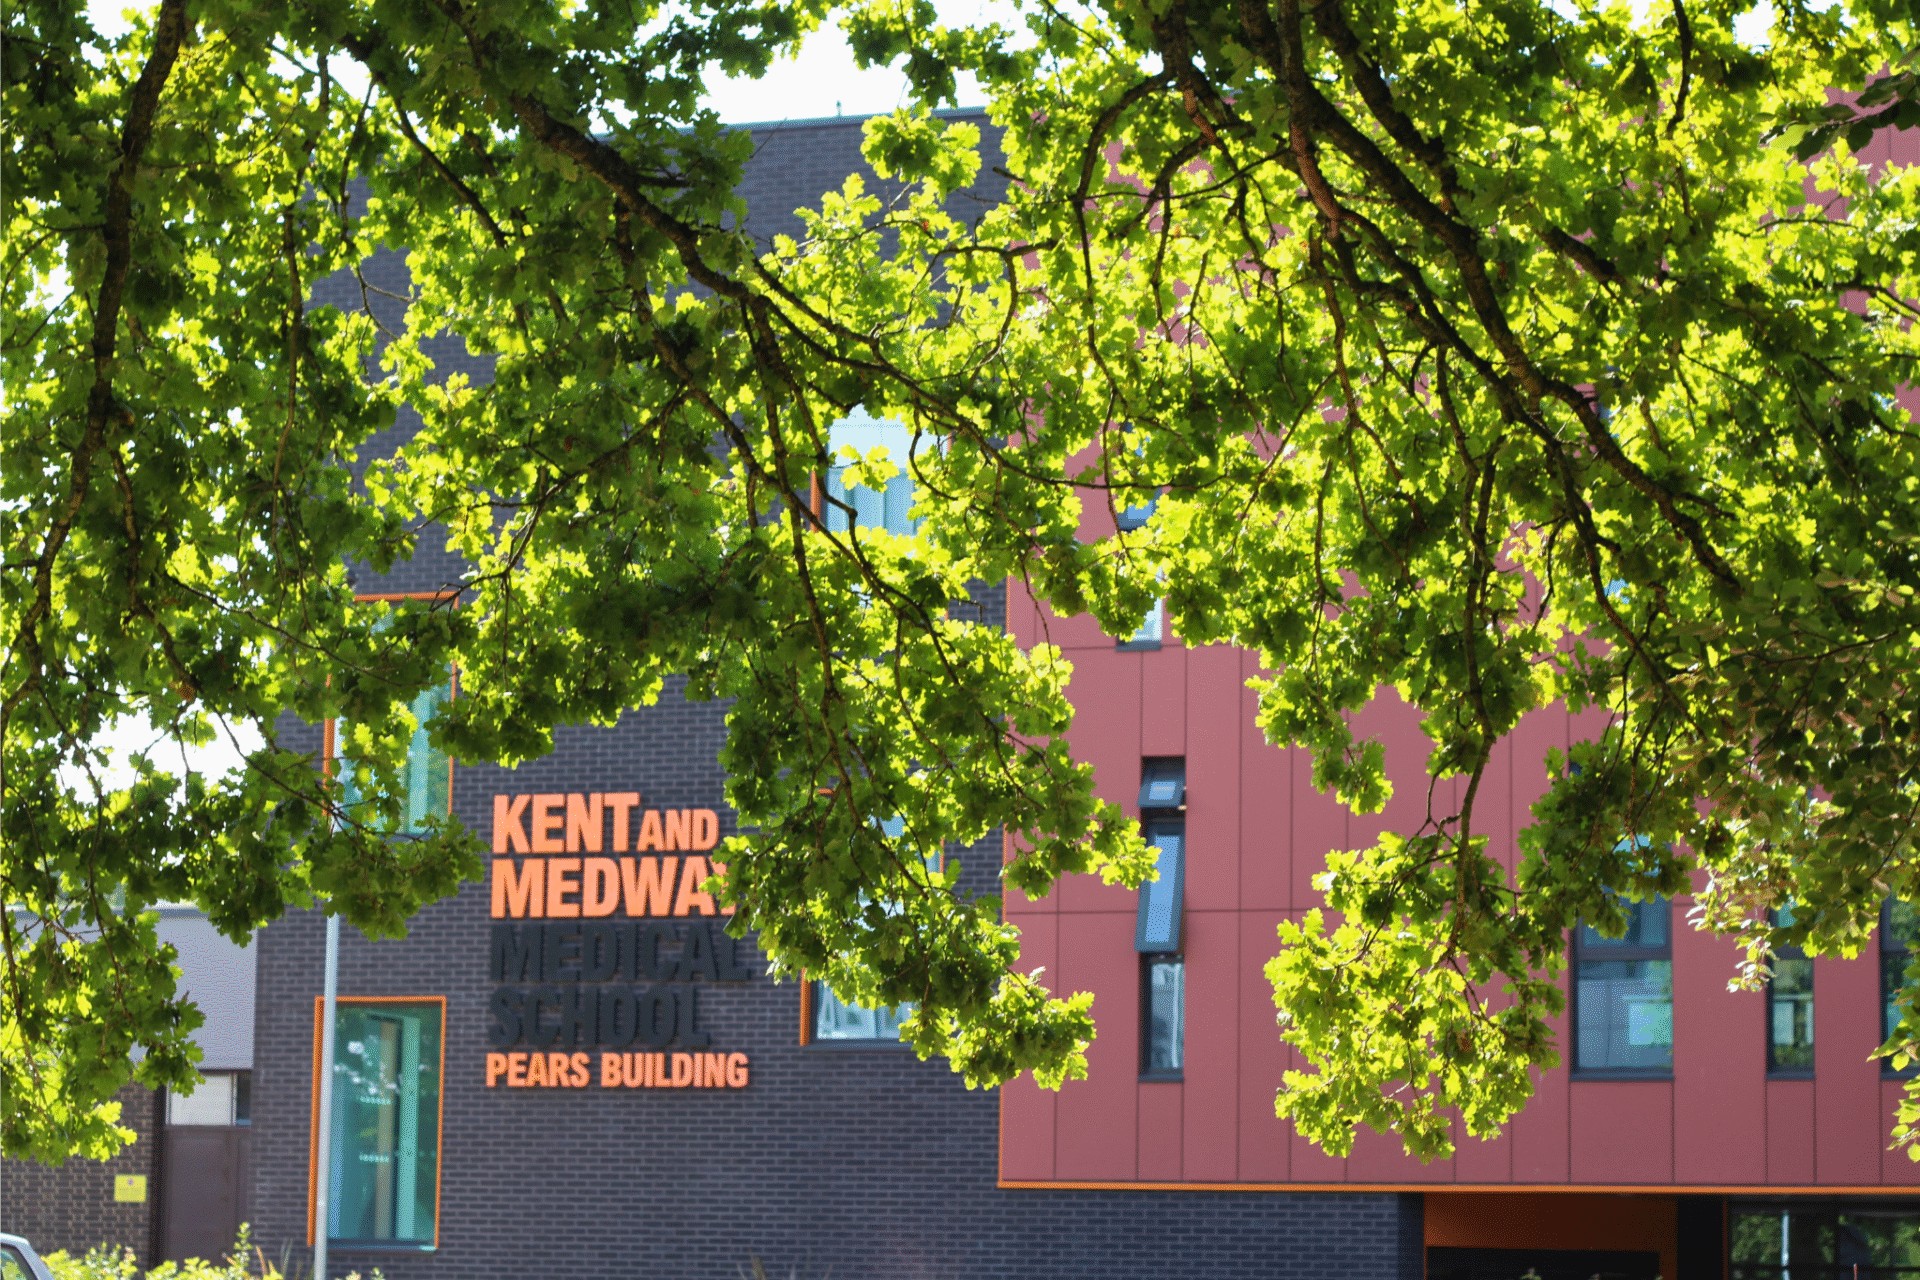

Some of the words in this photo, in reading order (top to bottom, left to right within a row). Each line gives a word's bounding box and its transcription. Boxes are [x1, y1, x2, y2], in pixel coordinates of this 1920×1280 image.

[493, 792, 641, 854] KENT
[636, 808, 720, 852] AND
[490, 921, 751, 982] MEDICAL
[488, 984, 712, 1046] SCHOOL
[485, 1051, 592, 1088] PEARS
[600, 1051, 750, 1089] BUILDING
